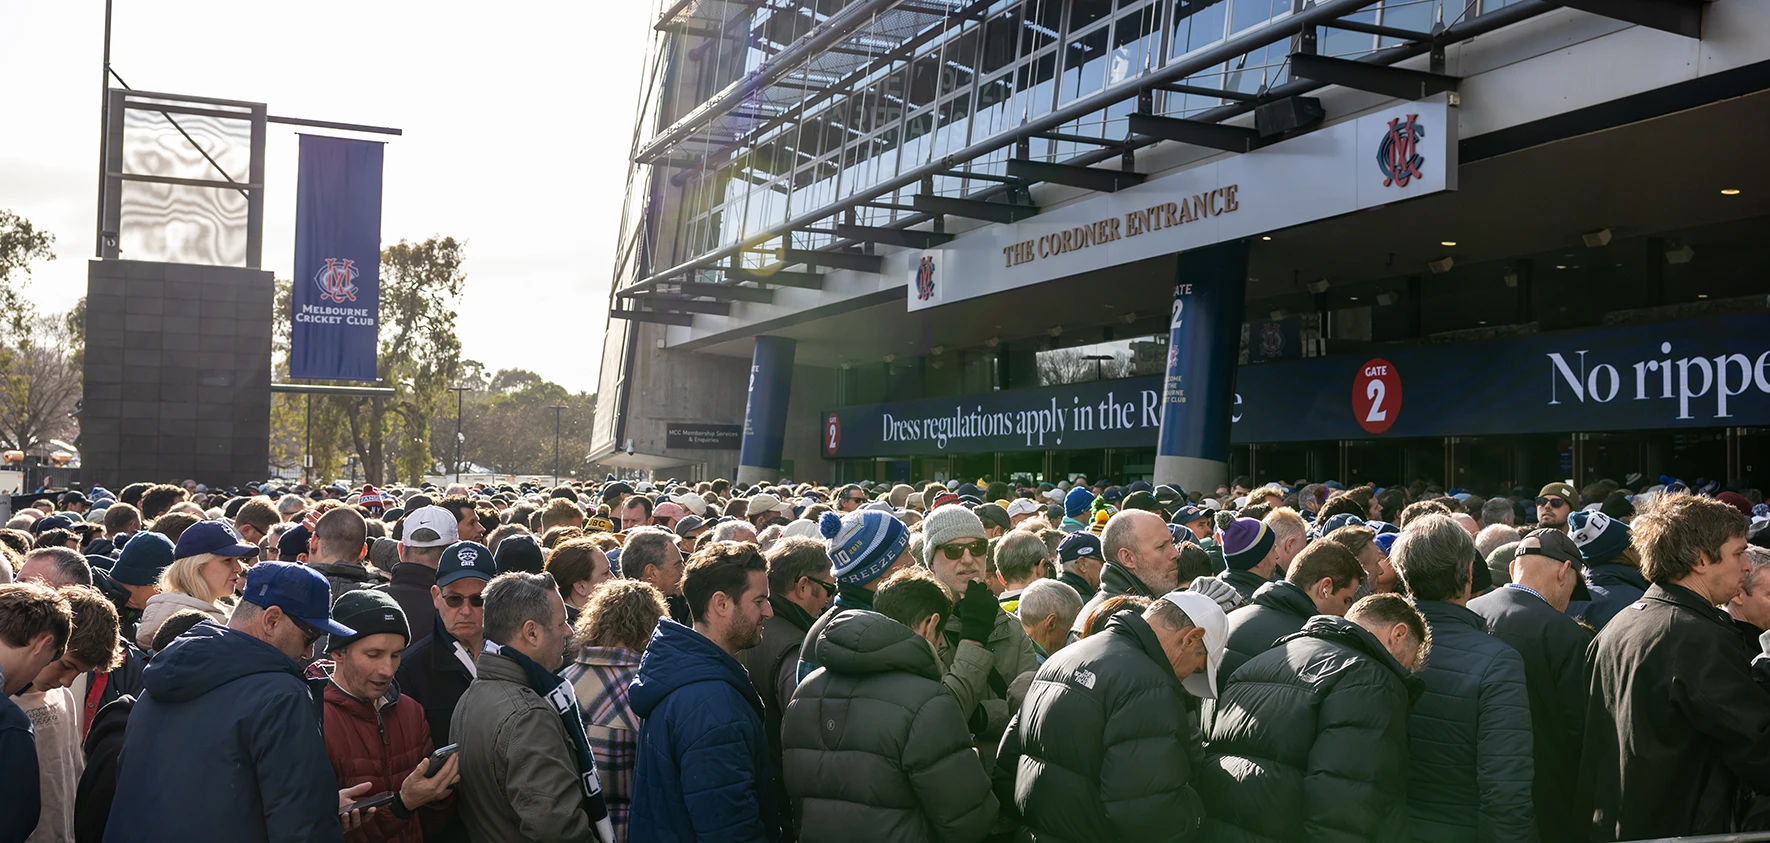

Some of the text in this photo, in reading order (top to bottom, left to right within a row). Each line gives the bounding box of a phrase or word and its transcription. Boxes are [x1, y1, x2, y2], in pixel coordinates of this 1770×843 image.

[1003, 184, 1239, 267] THE CORDNER ENTRANCE
[1173, 284, 1192, 297] ATE
[296, 313, 374, 326] CRICKET CLUB
[302, 304, 368, 316] MELBOURNE
[1170, 299, 1183, 330] 2
[1365, 366, 1387, 377] GATE
[1546, 350, 1620, 404] No
[1366, 379, 1387, 422] 2
[883, 413, 920, 441] Dress
[924, 405, 1012, 449] regulations
[1016, 397, 1069, 446] apply
[1074, 396, 1093, 431] in
[1098, 391, 1135, 430] the
[829, 424, 836, 448] 2
[834, 549, 851, 566] 10
